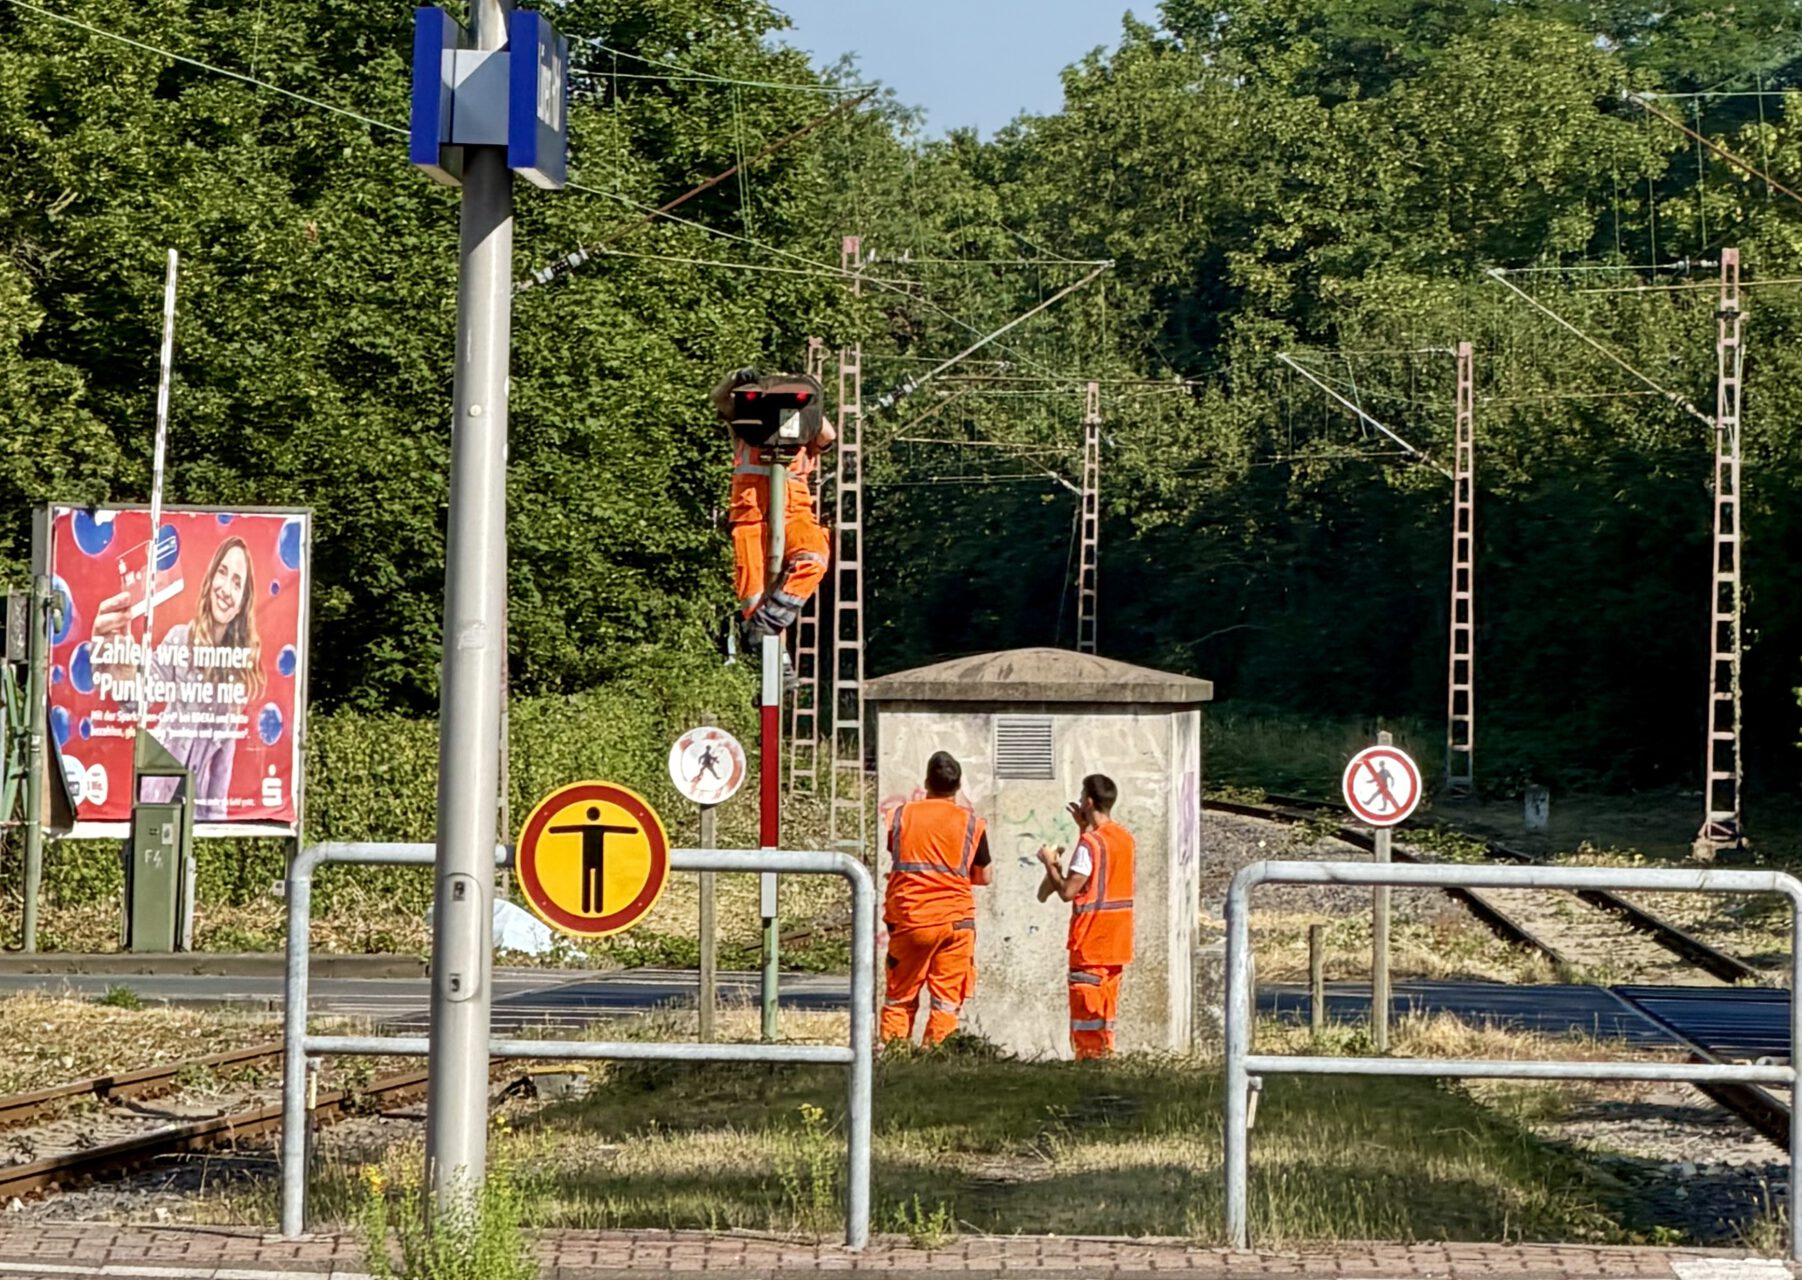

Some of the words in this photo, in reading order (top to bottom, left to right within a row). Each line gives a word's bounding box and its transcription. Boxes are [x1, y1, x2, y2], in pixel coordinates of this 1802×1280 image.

[157, 637, 189, 667] wie
[193, 638, 253, 669] immer.
[181, 674, 213, 704] wie
[217, 675, 248, 704] nie.
